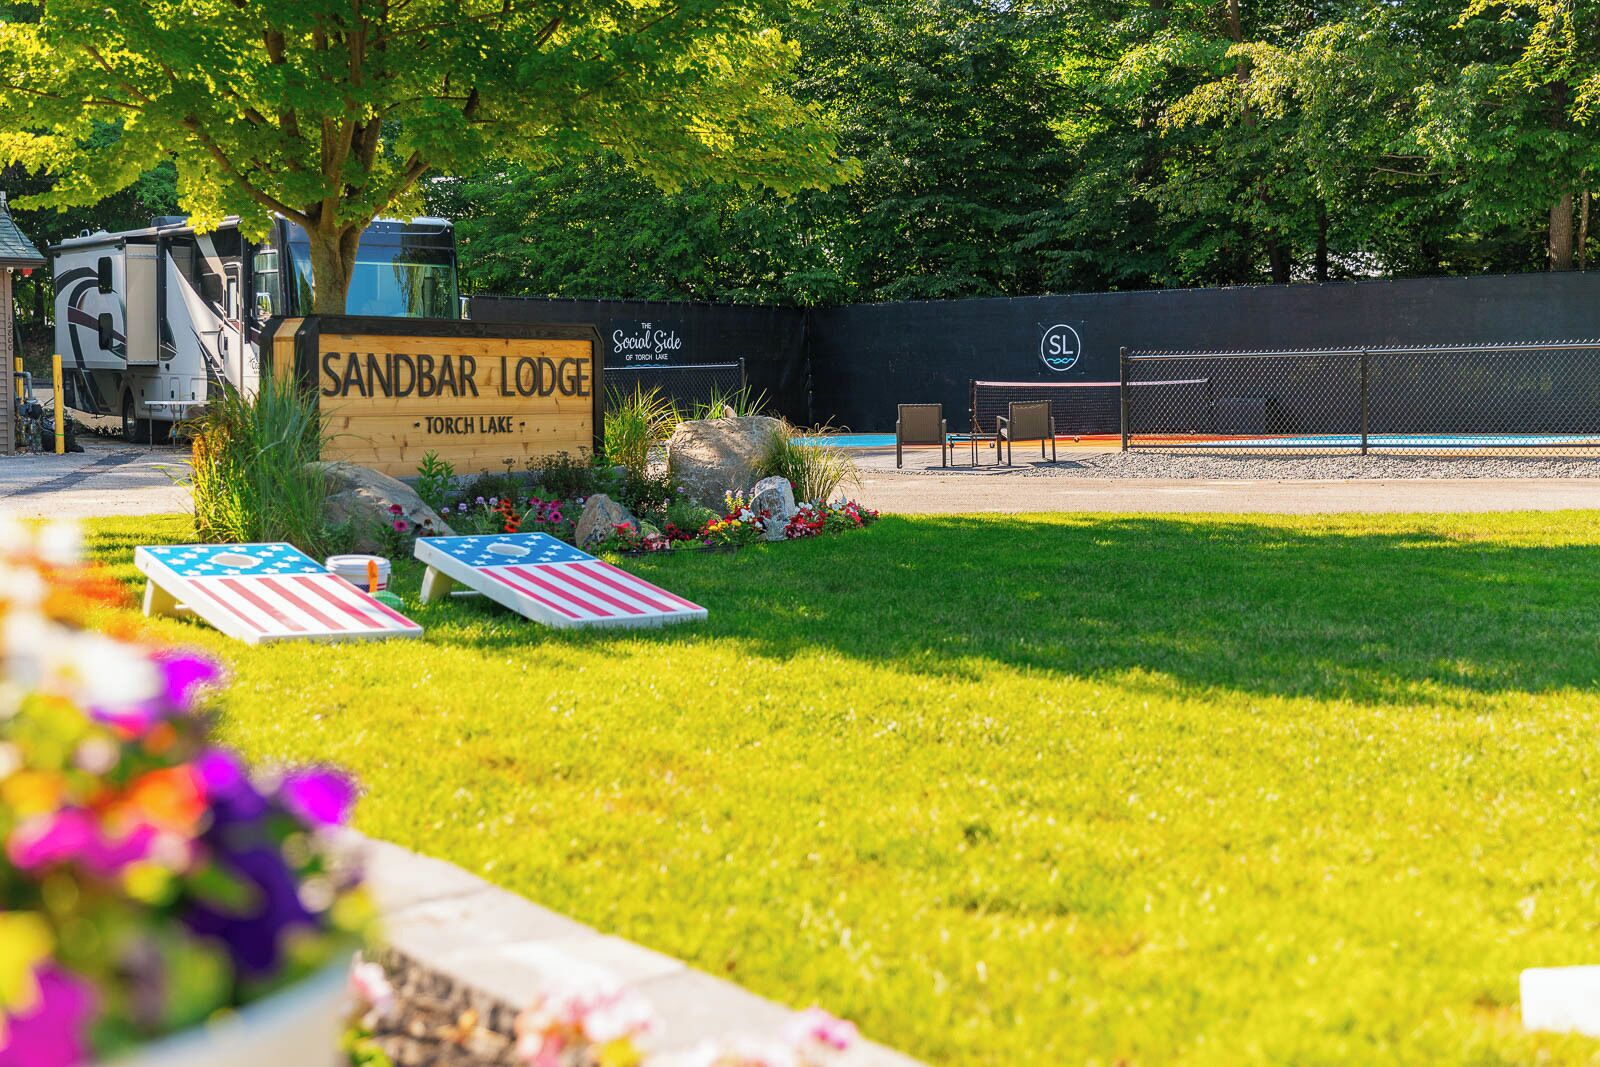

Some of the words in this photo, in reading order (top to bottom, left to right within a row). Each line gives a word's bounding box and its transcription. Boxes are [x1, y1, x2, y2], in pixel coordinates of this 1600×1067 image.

[641, 322, 652, 330] THE
[612, 329, 652, 354] Social
[653, 329, 682, 354] Side
[1049, 334, 1074, 355] SL
[322, 352, 480, 397] SANDBAR
[501, 356, 591, 397] LODGE
[425, 416, 475, 434] TORCH
[480, 416, 514, 434] LAKE
